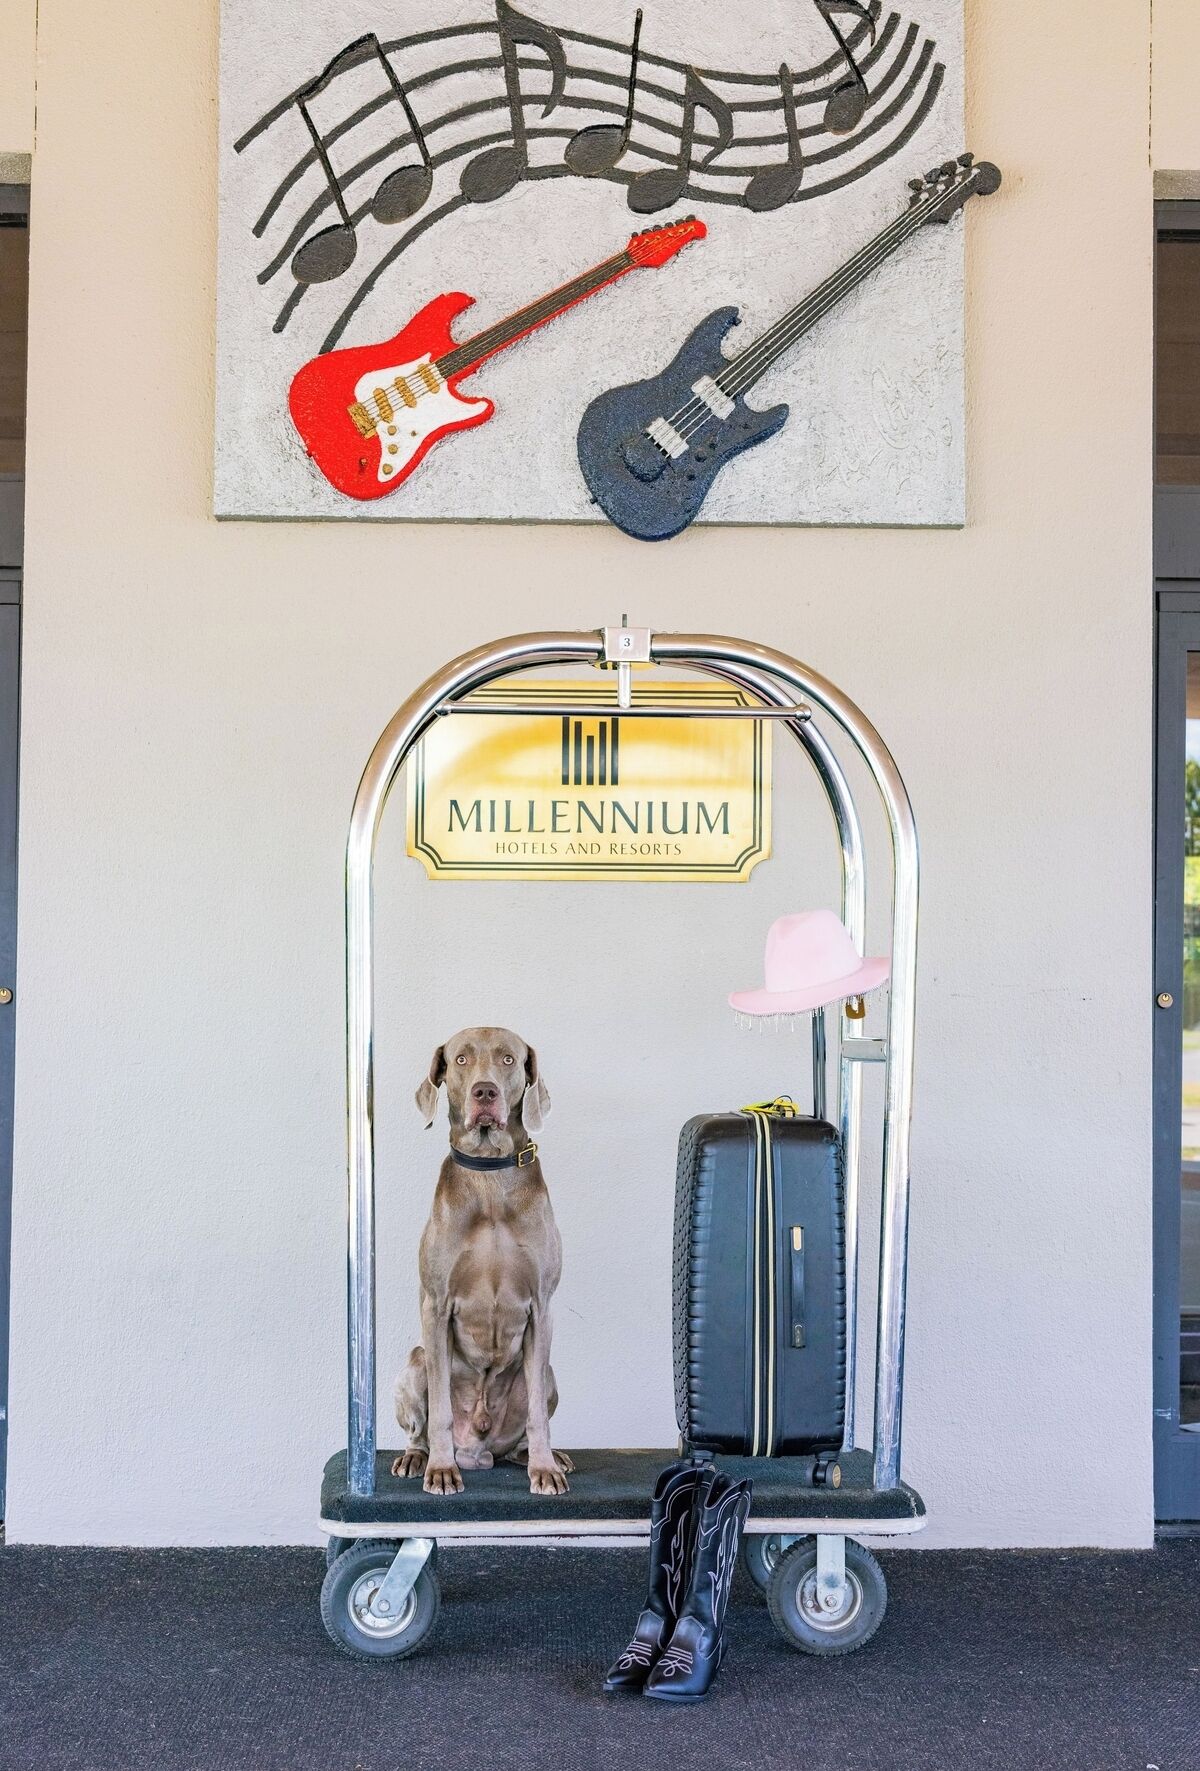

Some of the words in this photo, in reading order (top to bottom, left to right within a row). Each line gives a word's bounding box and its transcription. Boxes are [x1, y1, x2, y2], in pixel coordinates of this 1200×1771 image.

[623, 637, 631, 647] 3
[447, 799, 730, 834] MILLENNIUM
[495, 842, 558, 855] HOTELS
[565, 842, 601, 855] AND
[609, 842, 682, 856] RESORTS
